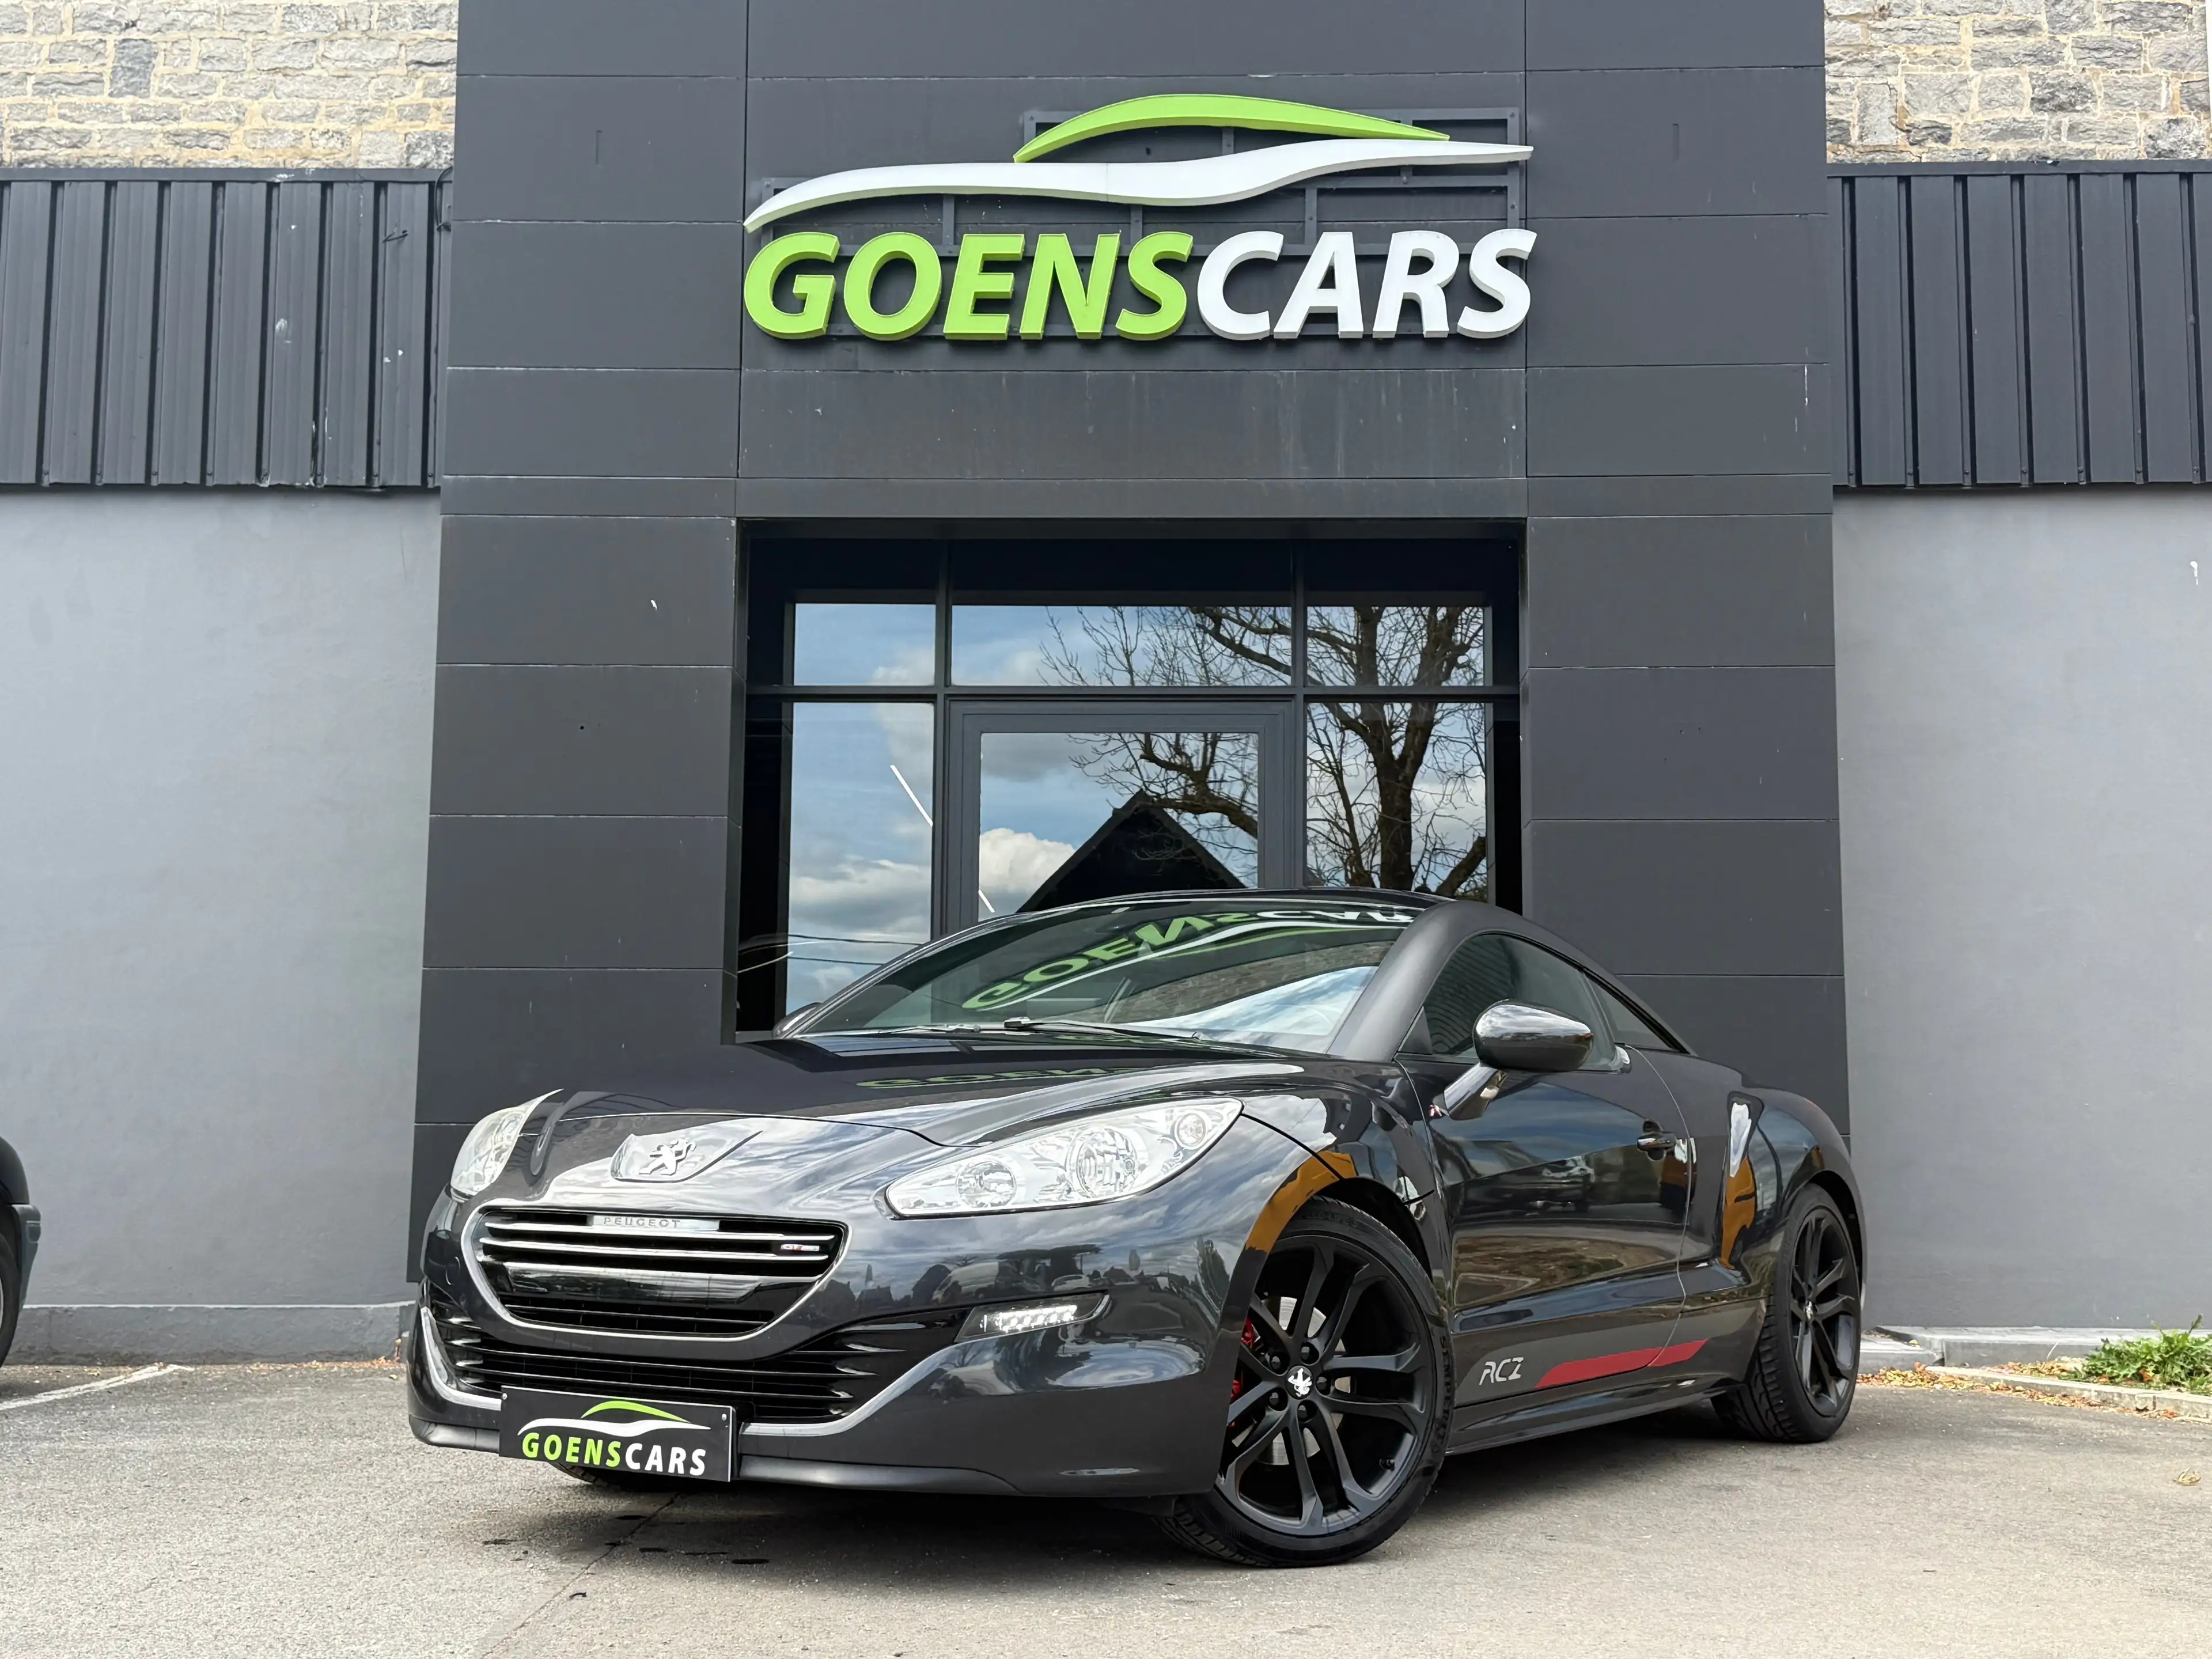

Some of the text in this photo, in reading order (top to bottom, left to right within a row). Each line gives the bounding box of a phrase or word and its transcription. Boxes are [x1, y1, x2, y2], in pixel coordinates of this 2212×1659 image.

[744, 229, 1537, 340] GOENSCARS
[604, 1217, 680, 1228] PEUGEOT
[1479, 1357, 1524, 1385] RCZ
[522, 1432, 706, 1476] GOENSCARS
